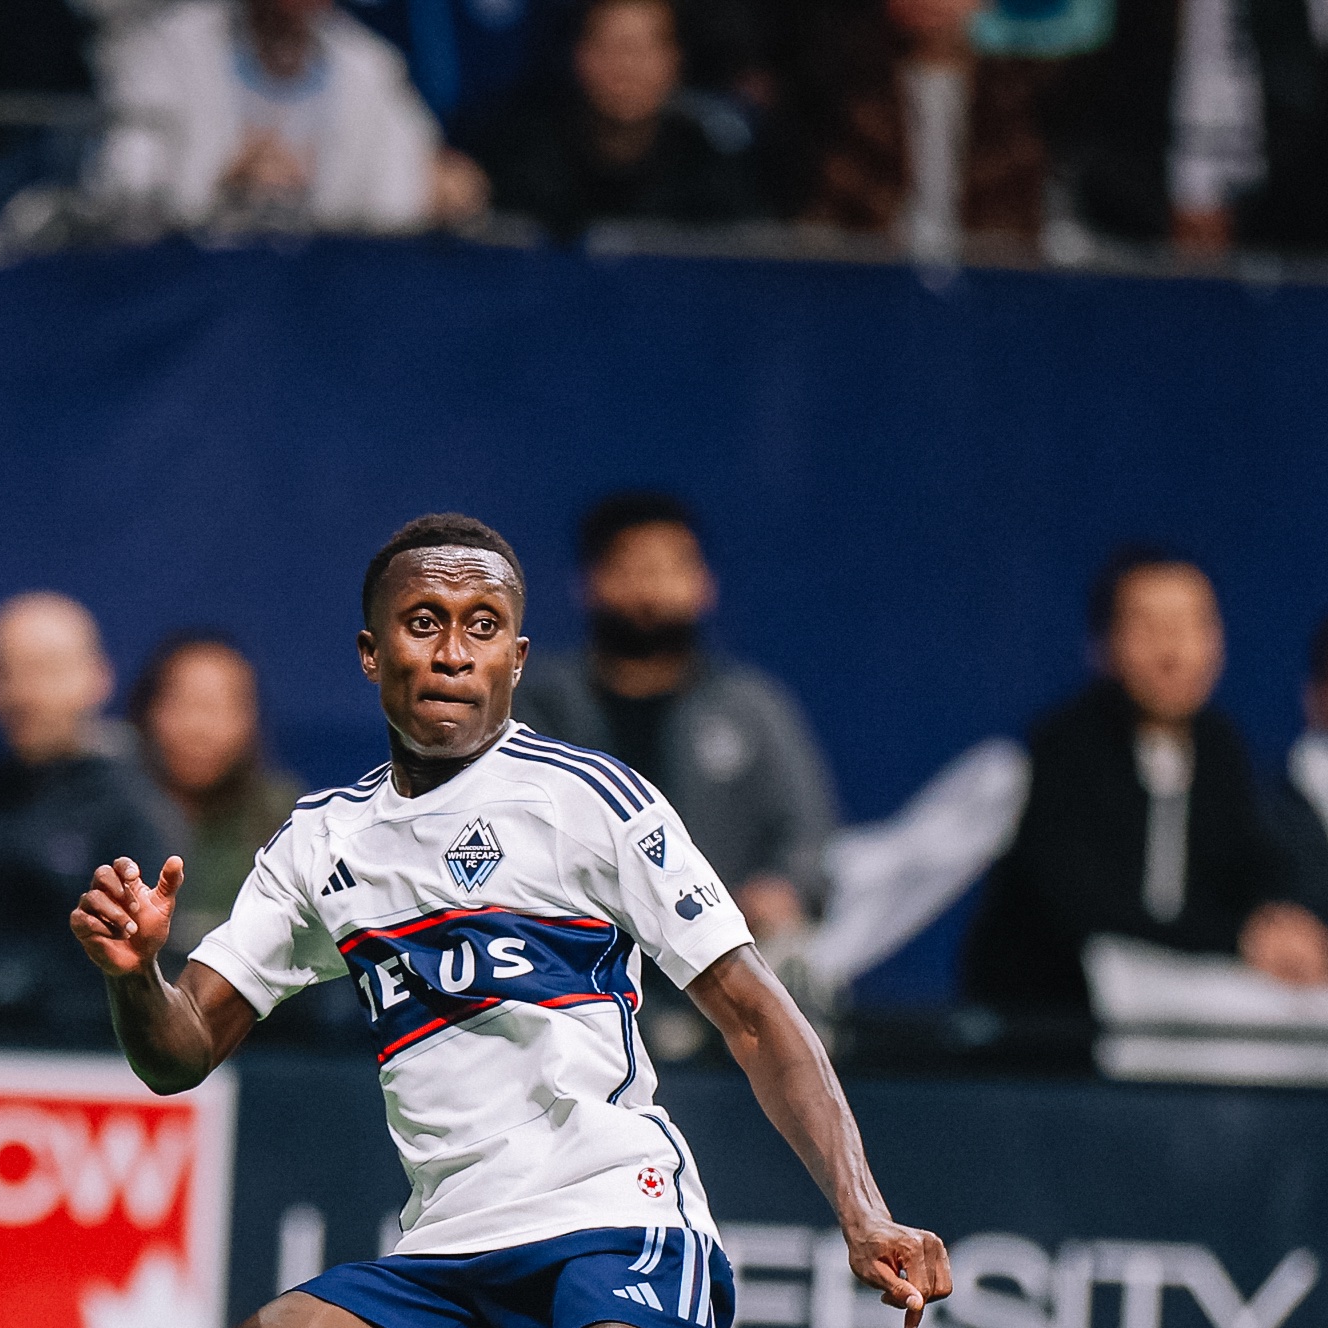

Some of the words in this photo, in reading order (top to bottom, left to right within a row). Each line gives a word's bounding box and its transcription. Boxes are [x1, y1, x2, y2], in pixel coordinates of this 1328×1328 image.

[639, 830, 664, 852] MLS
[447, 851, 501, 860] WHITECAPS
[465, 860, 478, 869] FC
